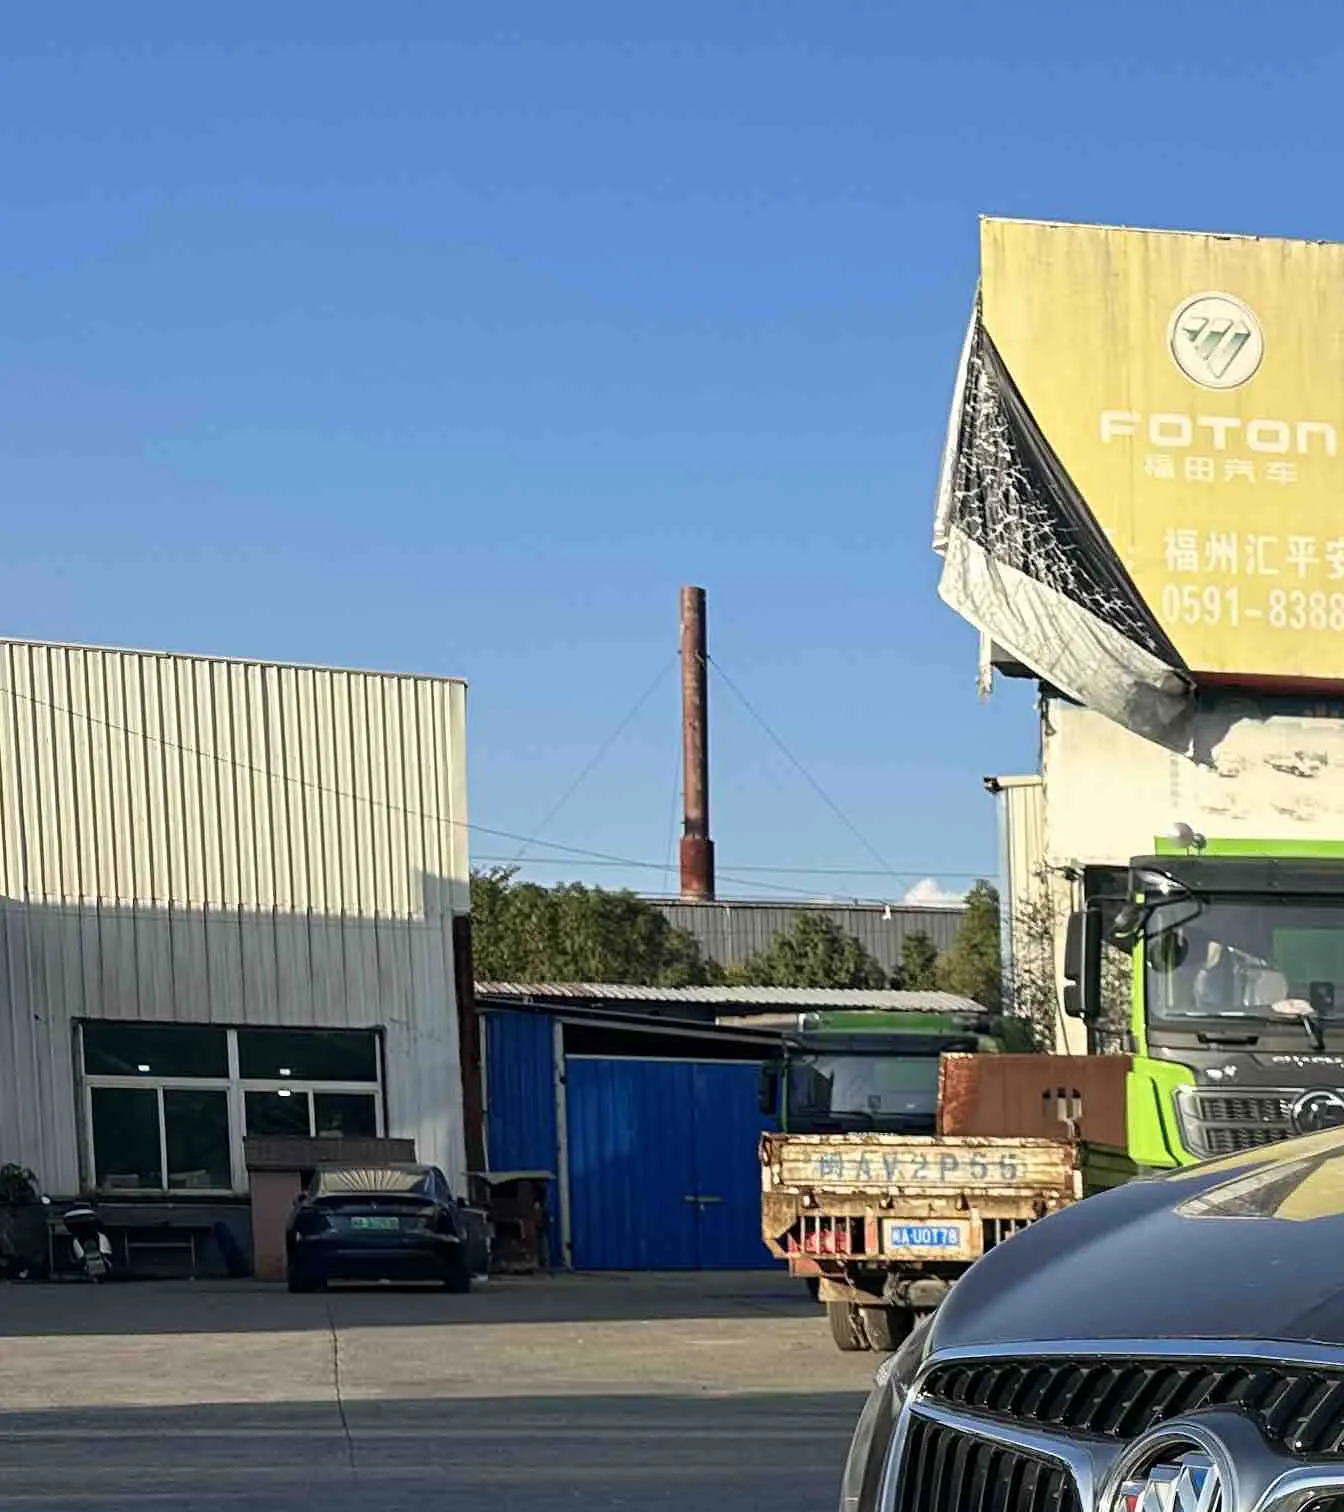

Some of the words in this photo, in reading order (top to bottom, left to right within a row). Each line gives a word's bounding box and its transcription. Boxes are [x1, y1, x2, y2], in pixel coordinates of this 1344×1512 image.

[1099, 410, 1338, 456] FOTON
[1143, 454, 1299, 486] 福田汽车
